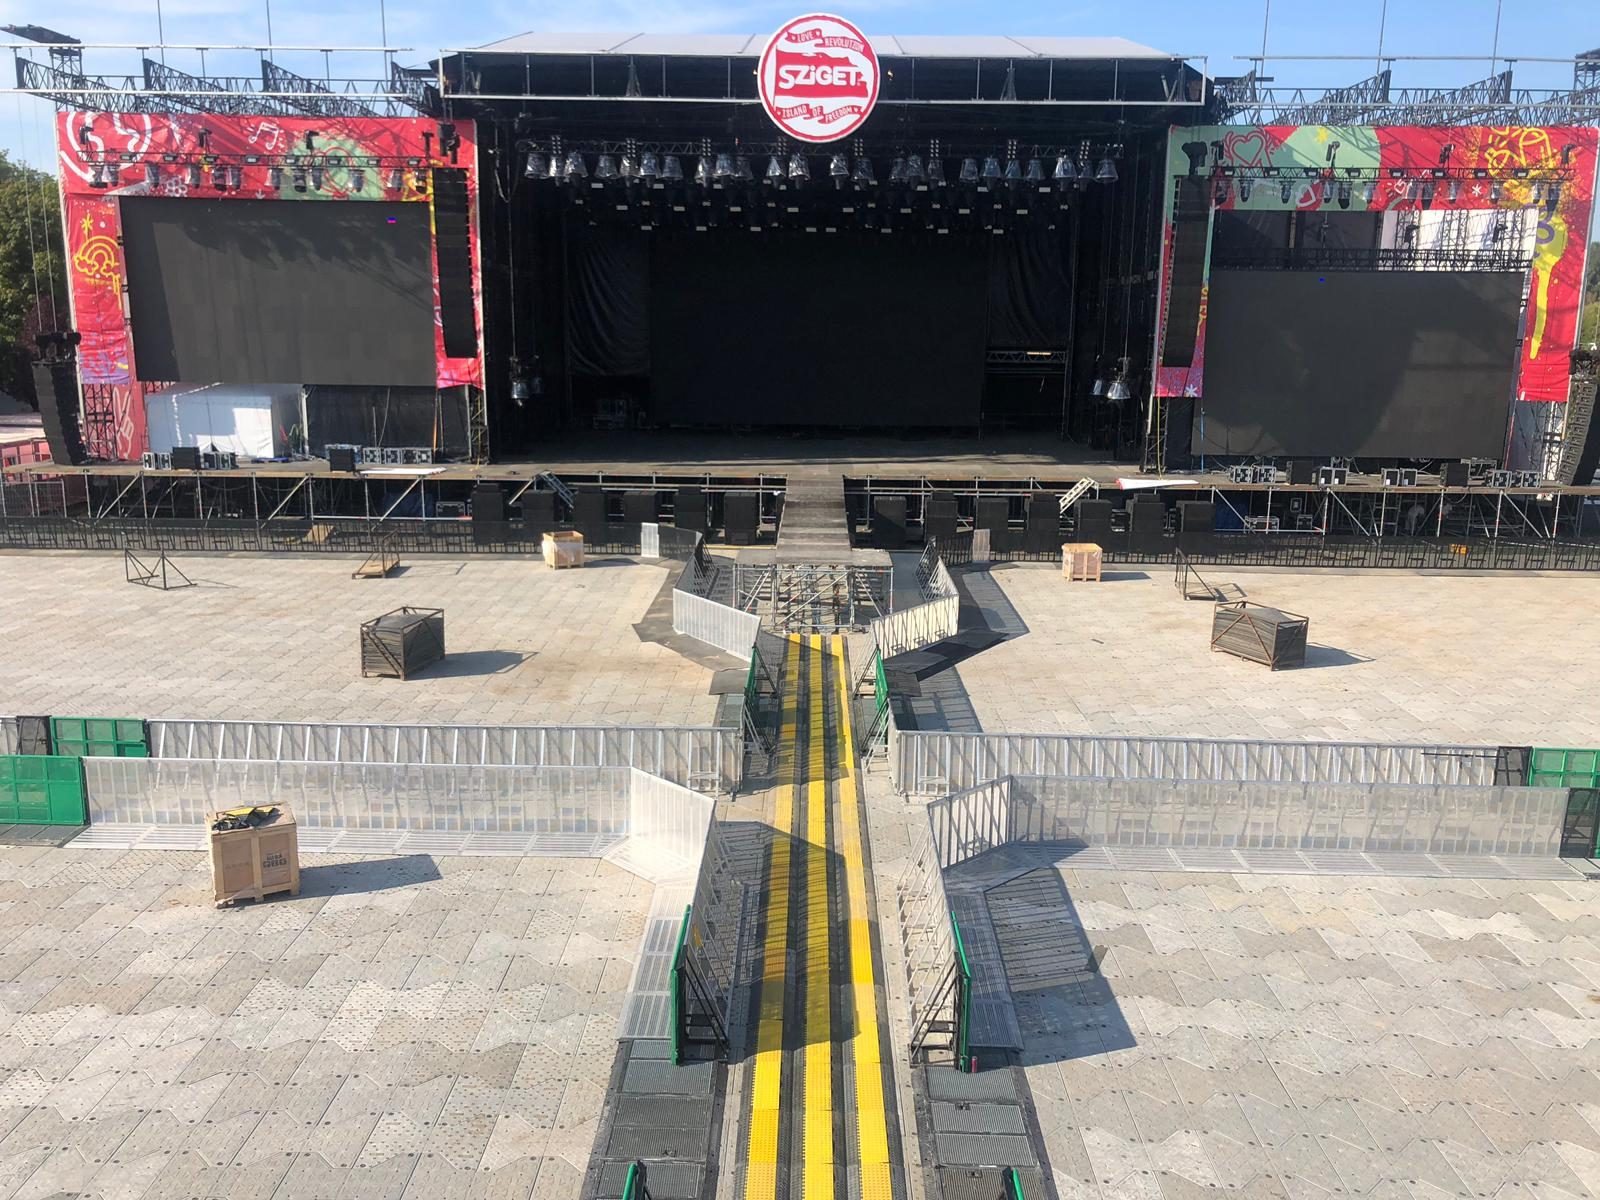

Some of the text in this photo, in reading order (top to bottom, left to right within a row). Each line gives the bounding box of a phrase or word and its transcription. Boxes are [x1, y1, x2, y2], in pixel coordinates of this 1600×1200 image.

[797, 30, 865, 53] LOVE REVOLUTION
[782, 105, 852, 123] ISLAND OF FREEDOM
